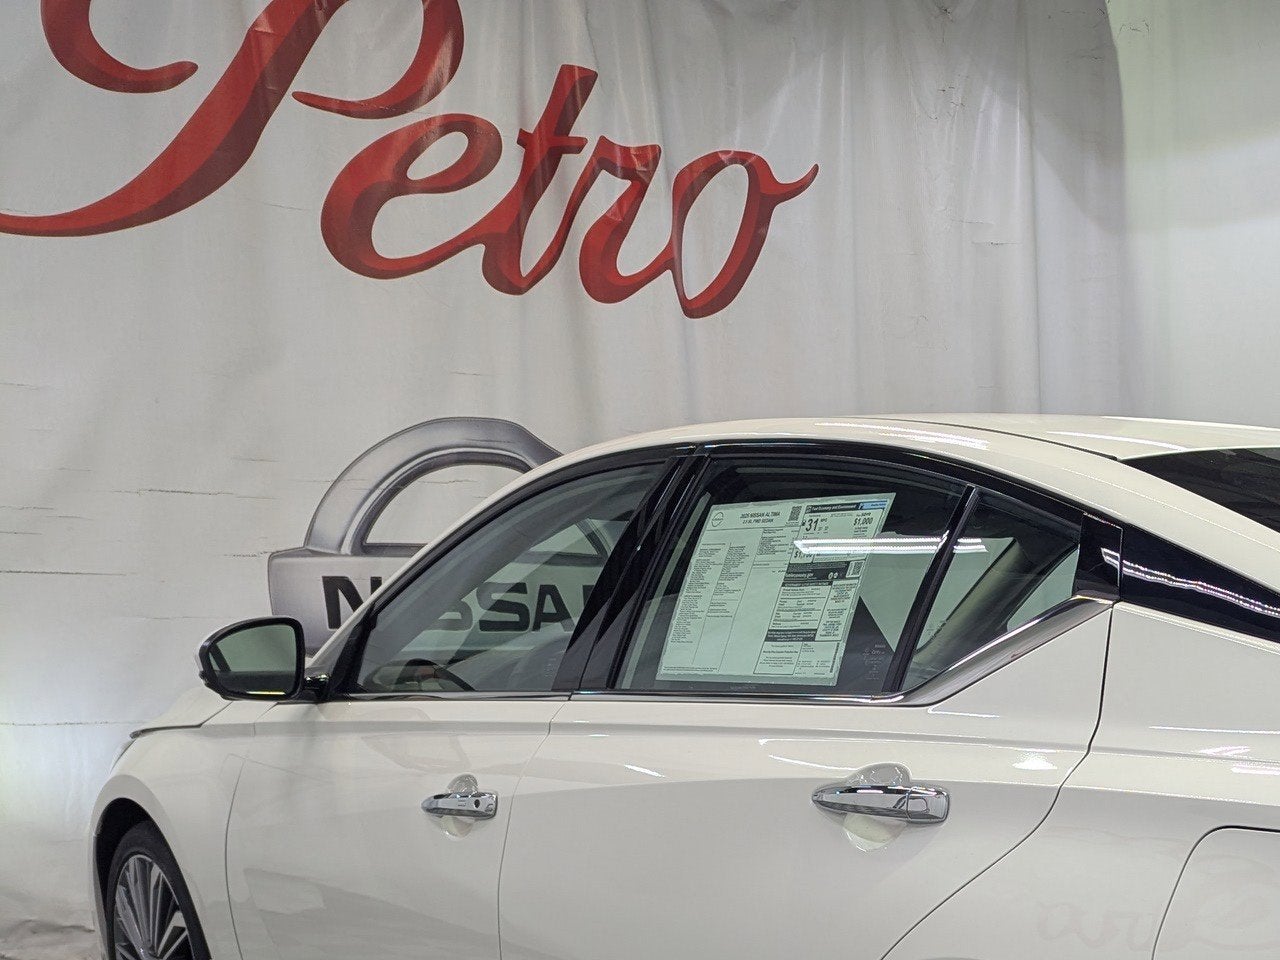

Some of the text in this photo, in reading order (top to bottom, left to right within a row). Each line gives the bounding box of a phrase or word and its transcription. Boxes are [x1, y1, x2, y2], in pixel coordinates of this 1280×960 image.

[0, 0, 819, 319] Petro
[805, 518, 819, 532] 31
[854, 517, 873, 526] $1,000
